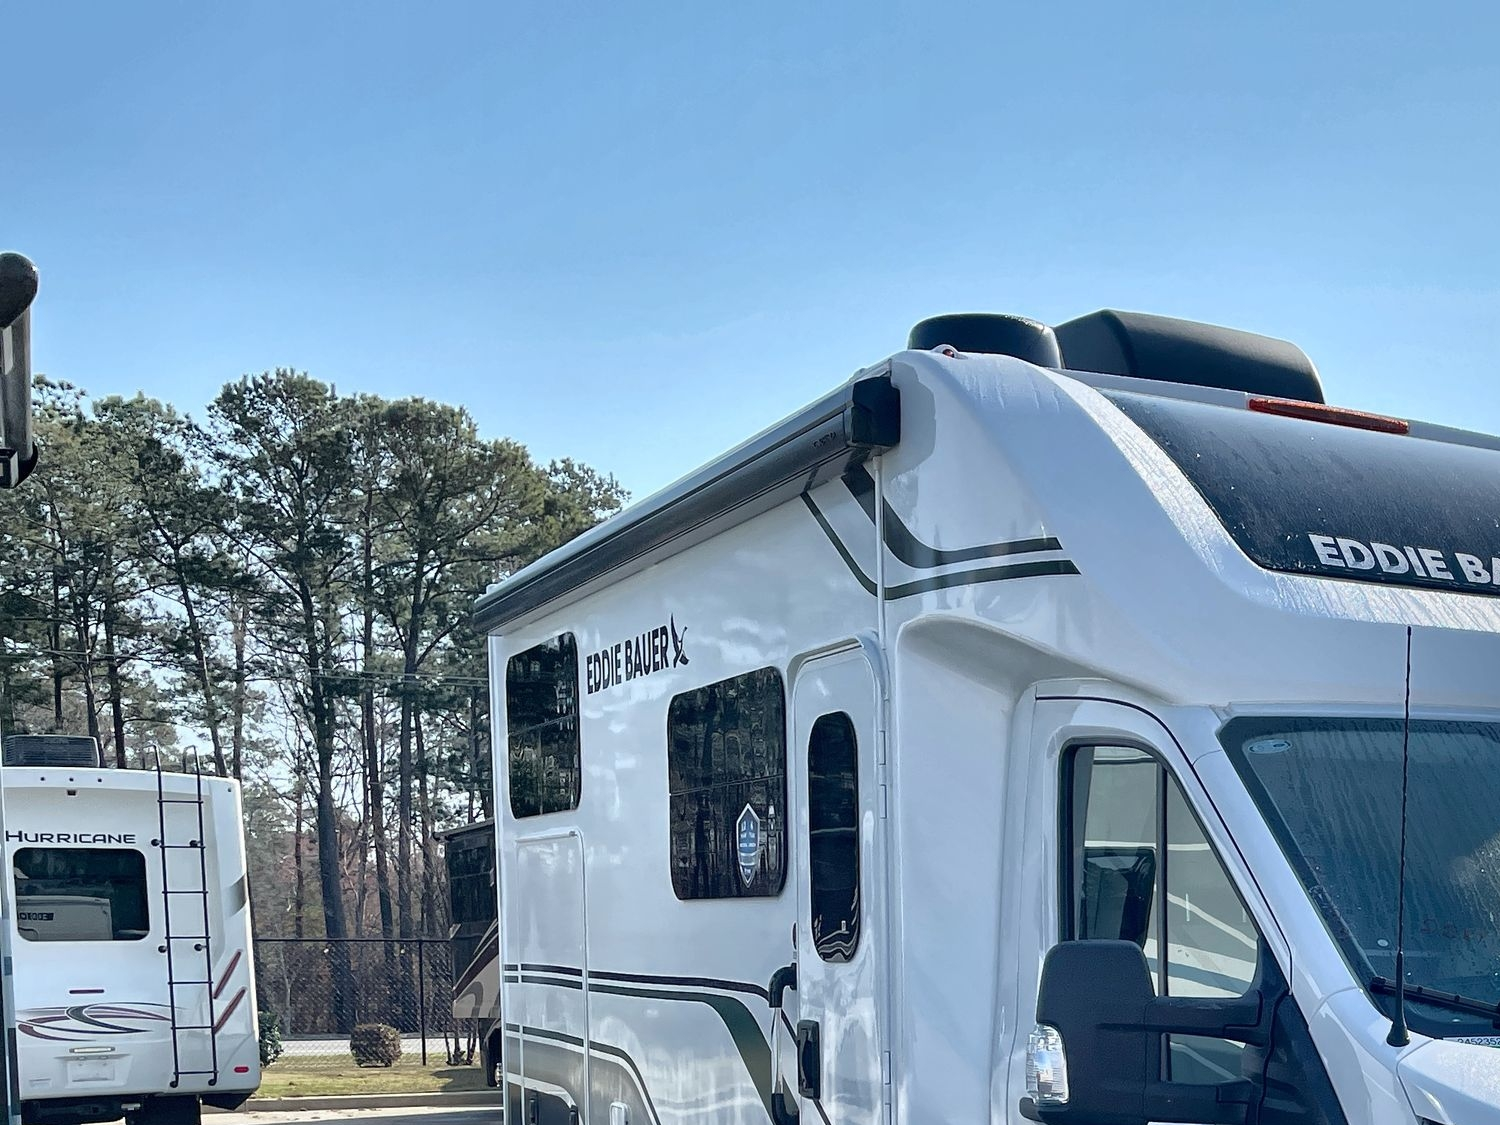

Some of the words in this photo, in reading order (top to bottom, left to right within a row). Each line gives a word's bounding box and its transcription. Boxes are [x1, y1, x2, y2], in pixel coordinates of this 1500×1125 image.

[1308, 534, 1455, 580] EDDIE
[587, 643, 622, 694] EDDIE
[625, 625, 669, 681] BAUER
[5, 830, 137, 845] HURRICANE
